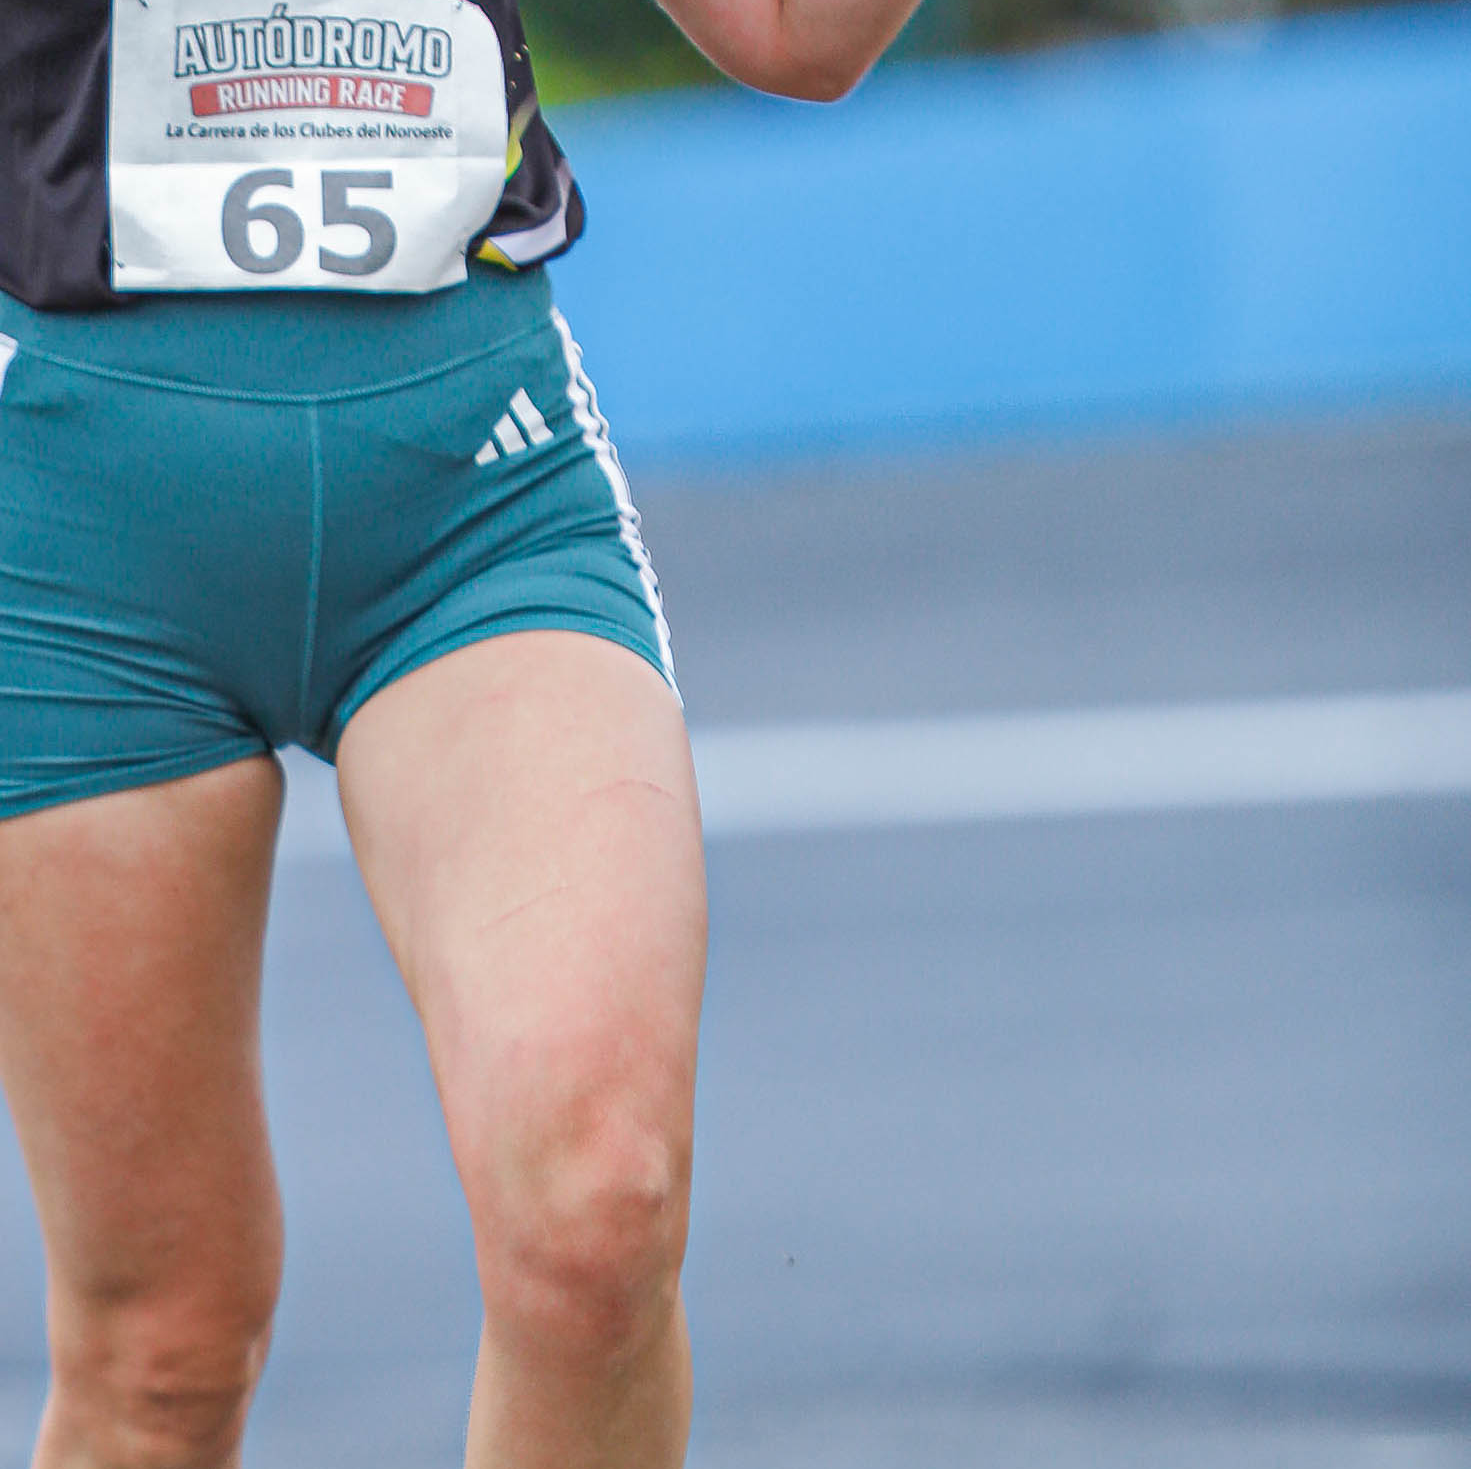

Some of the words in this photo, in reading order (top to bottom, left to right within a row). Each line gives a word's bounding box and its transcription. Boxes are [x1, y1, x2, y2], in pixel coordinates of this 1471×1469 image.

[174, 3, 452, 78] AUTÓDROMO
[216, 77, 330, 111] RUNNING
[338, 77, 407, 111] RACE
[166, 123, 184, 138] La
[188, 122, 246, 138] Carrera
[250, 122, 270, 138] de
[273, 122, 295, 138] los
[300, 122, 353, 139] Clubes
[357, 122, 381, 139] del
[385, 122, 454, 140] Noroeste
[221, 168, 398, 276] 65
